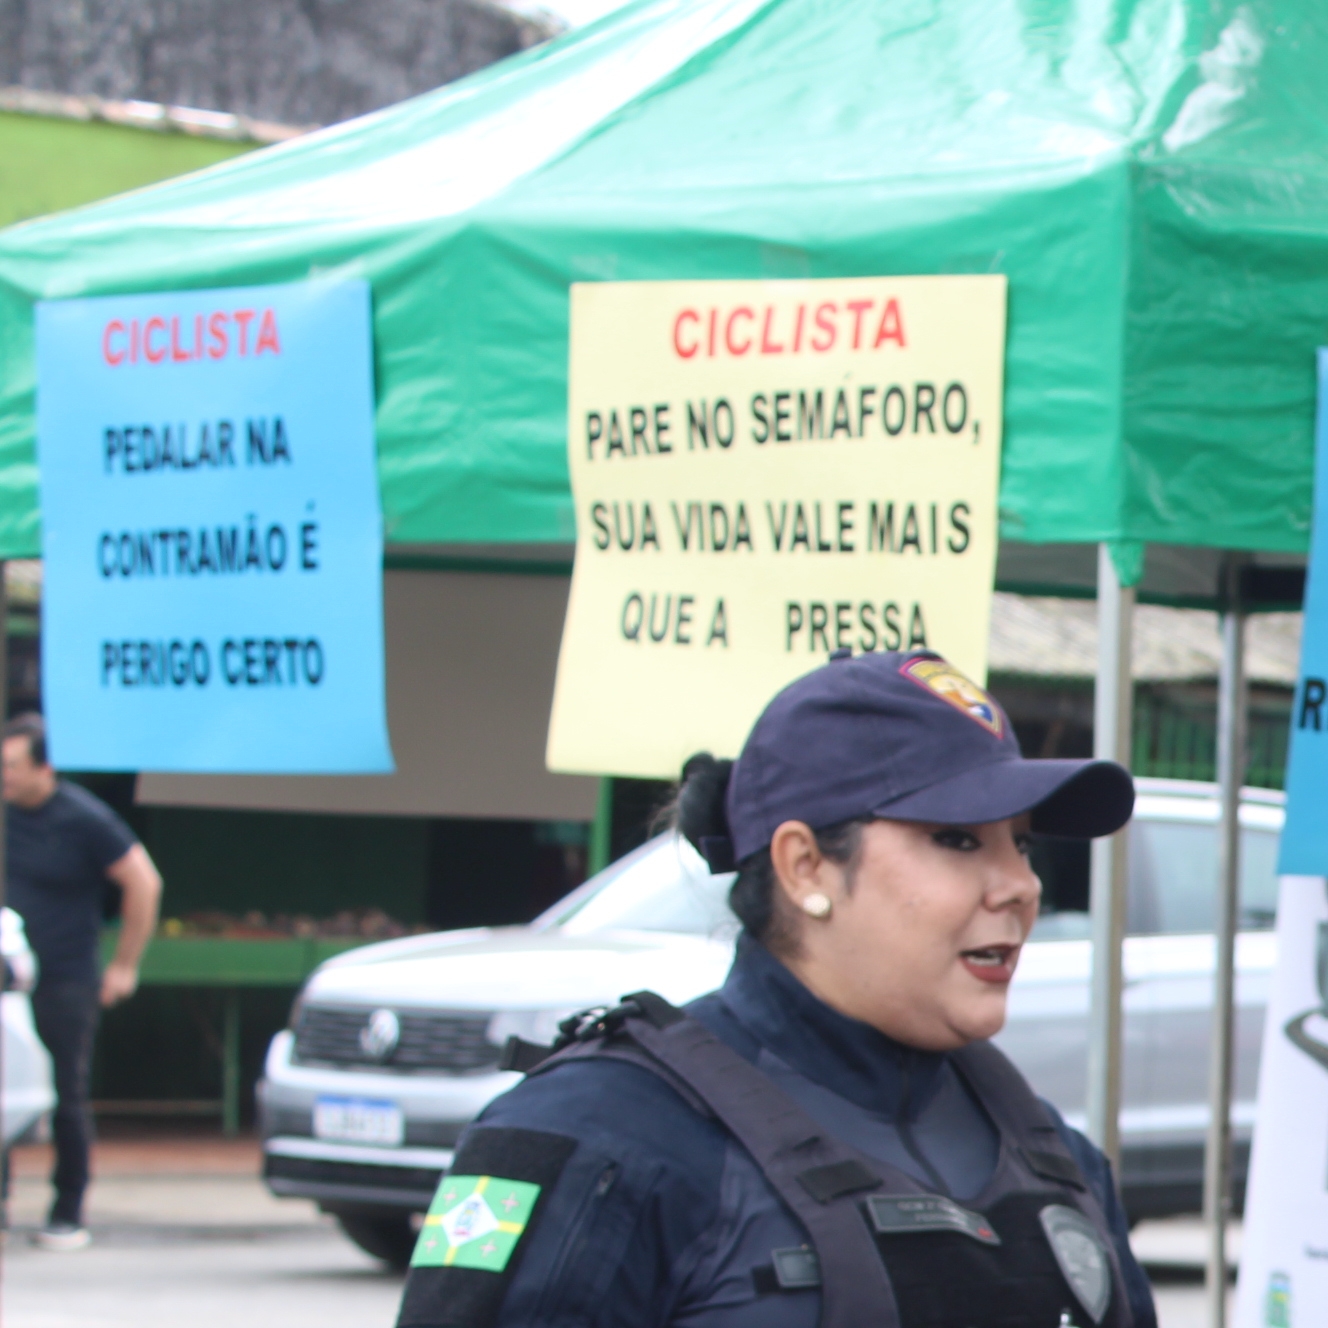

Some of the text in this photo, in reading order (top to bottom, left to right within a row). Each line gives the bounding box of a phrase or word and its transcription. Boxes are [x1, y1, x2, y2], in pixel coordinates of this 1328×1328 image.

[103, 309, 280, 365] CICLISTA
[674, 298, 906, 359] CICLISTA
[104, 415, 291, 473] PEDALAR NA
[586, 372, 981, 461] PARE NO SEMÁFORO,
[99, 500, 319, 578] CONTRAMÃO É
[591, 501, 972, 555] SUA VIDA VALE MAIS
[620, 591, 928, 652] QUE A PRESSA
[103, 637, 324, 687] PERIGO CERTO
